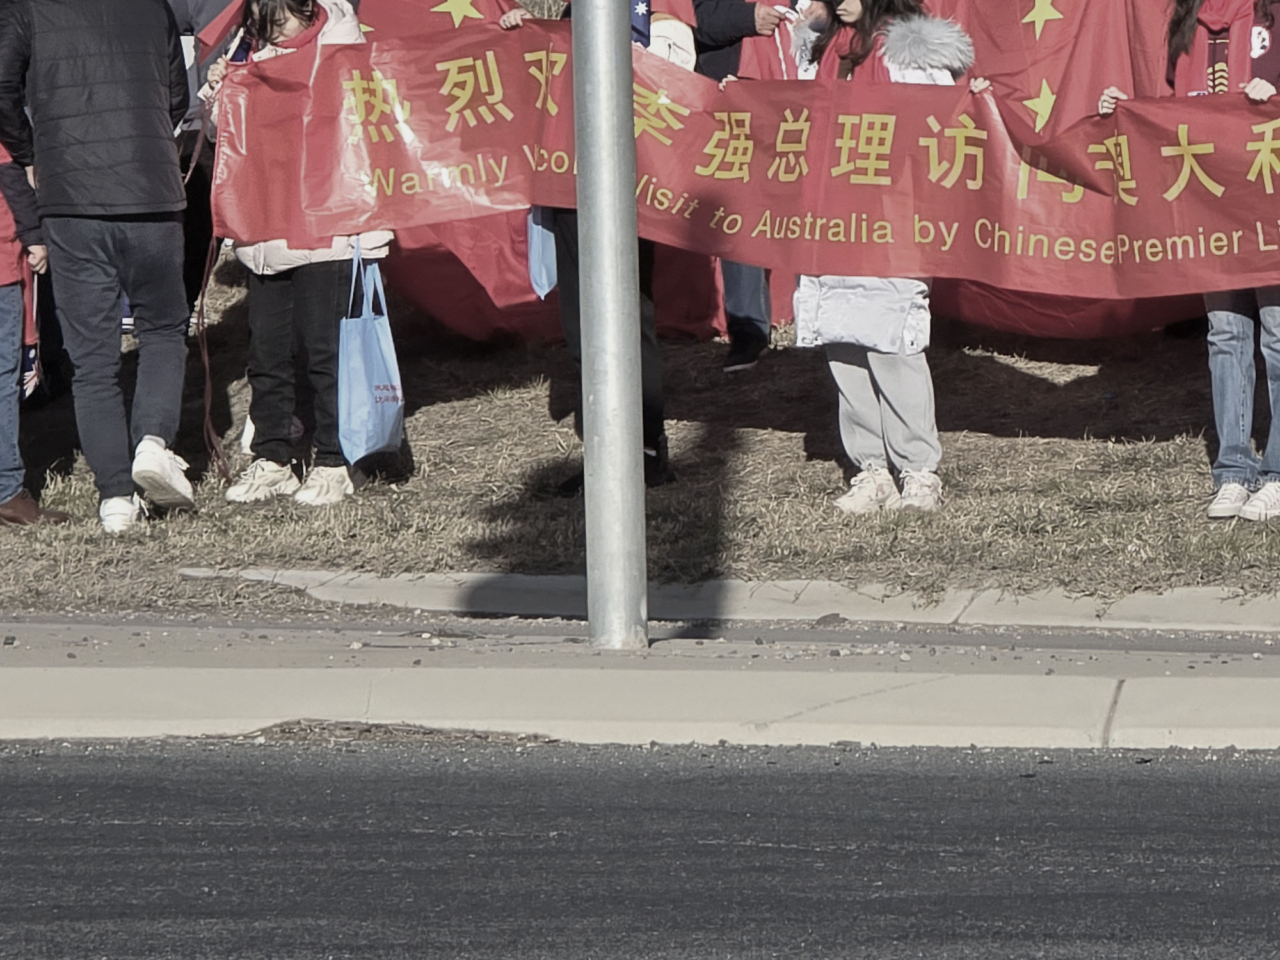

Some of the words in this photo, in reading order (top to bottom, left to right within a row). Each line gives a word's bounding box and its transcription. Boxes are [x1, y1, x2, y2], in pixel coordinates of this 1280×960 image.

[362, 153, 508, 198] Warmly
[709, 206, 742, 234] to
[751, 210, 894, 243] Australia
[914, 214, 959, 251] by
[974, 218, 1115, 264] Chinese
[1117, 226, 1243, 264] Premier
